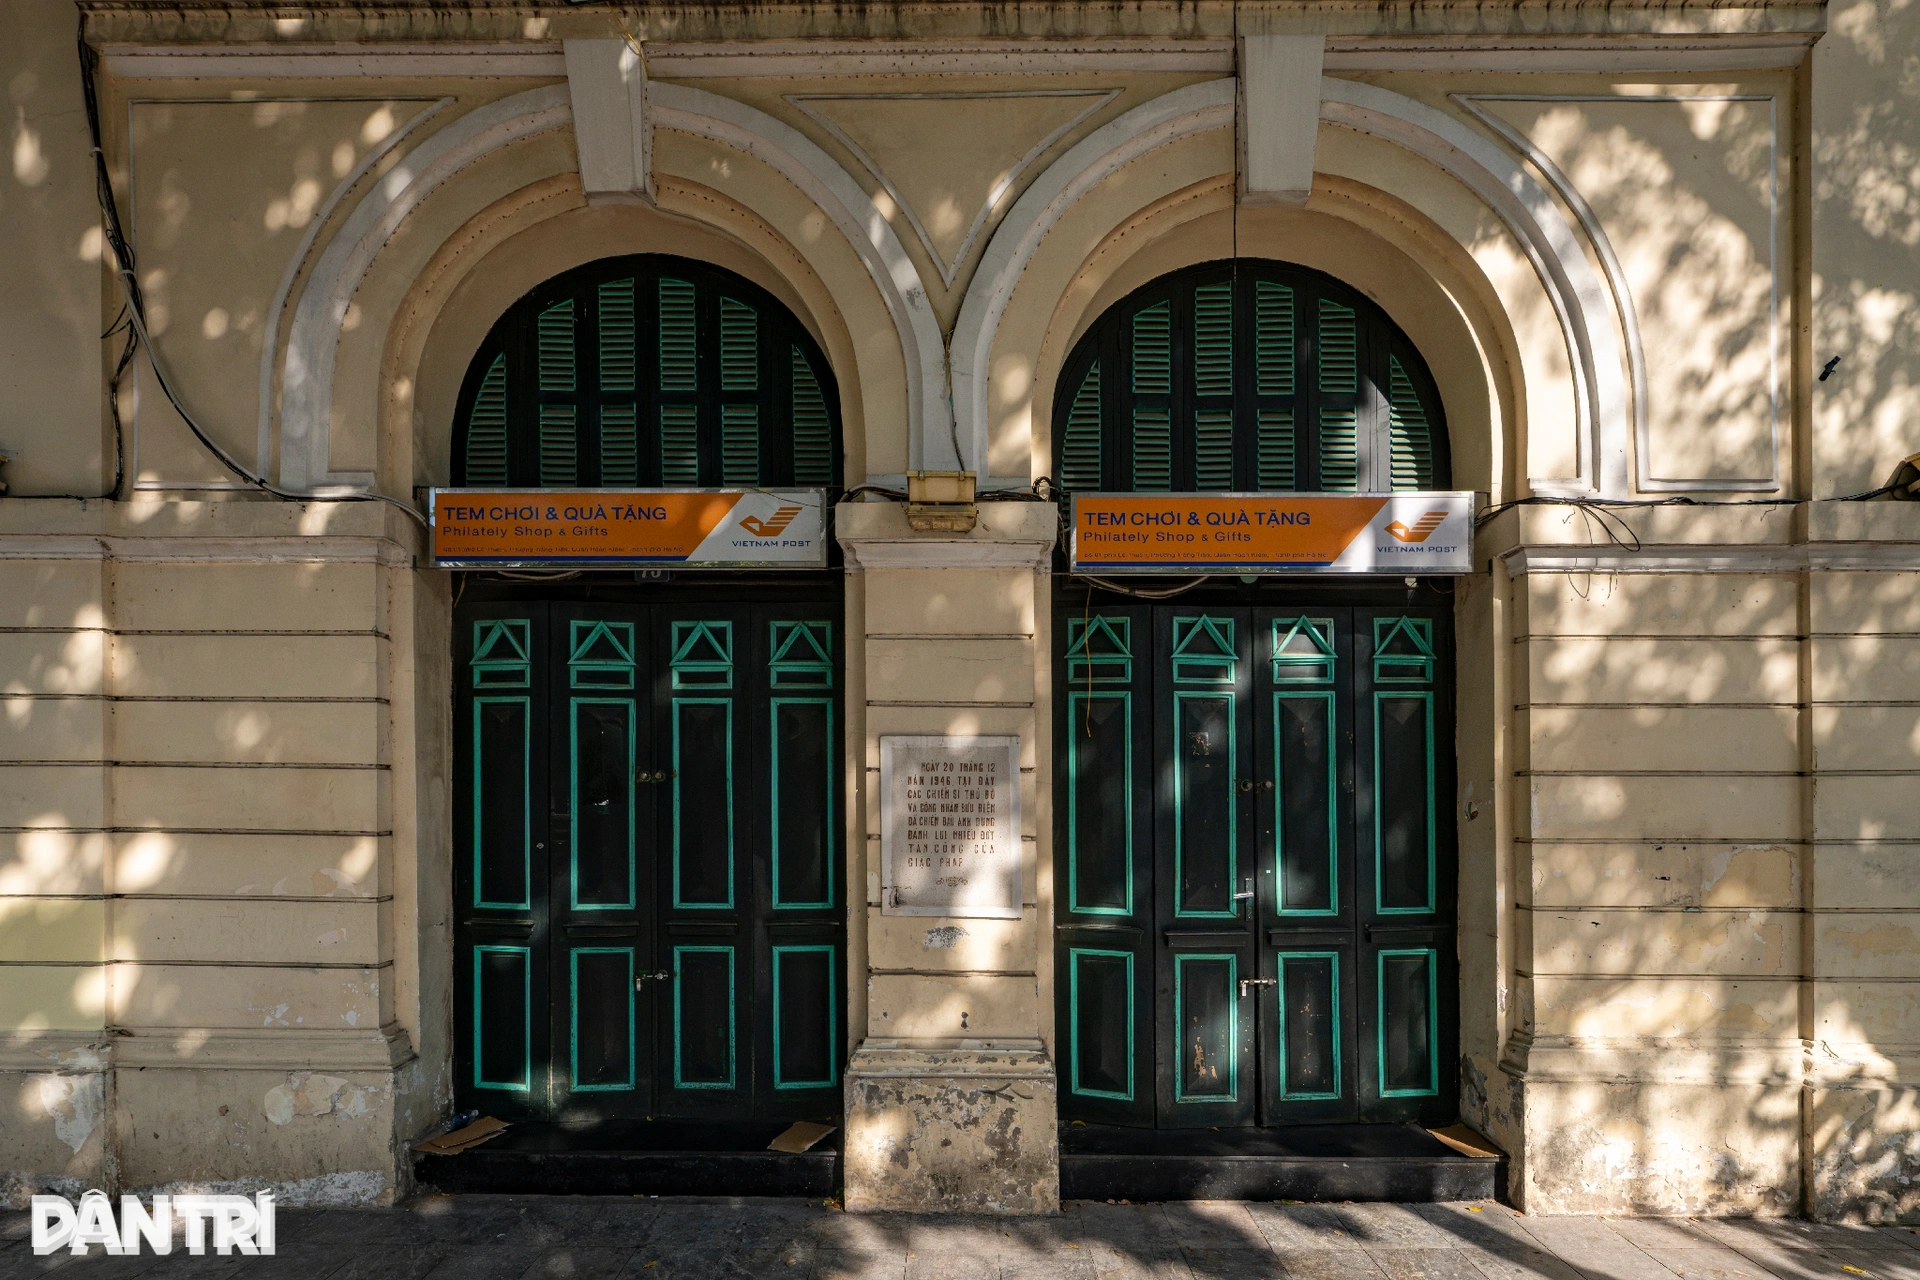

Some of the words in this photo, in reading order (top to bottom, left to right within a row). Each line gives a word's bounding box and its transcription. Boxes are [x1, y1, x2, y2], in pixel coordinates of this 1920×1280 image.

[443, 507, 485, 521] TEM
[489, 506, 539, 521] CHƠI
[545, 507, 560, 521] &
[564, 504, 607, 521] QUÀ
[611, 504, 667, 523] TẶNG
[1084, 512, 1127, 526] TEM
[1130, 511, 1181, 526] CHƠI
[1187, 512, 1201, 526] &
[1206, 509, 1250, 526] QUÀ
[1254, 509, 1310, 528] TẶNG
[443, 526, 508, 538] Philately
[514, 526, 553, 538] Shop
[558, 528, 567, 536] &
[572, 526, 608, 536] Gifts
[1084, 532, 1149, 544] Philately
[1156, 531, 1195, 543] Shop
[1201, 534, 1209, 542] &
[1214, 531, 1251, 542] Gifts
[731, 540, 779, 548] VIETNAM
[782, 540, 811, 548] POST
[943, 762, 954, 772] 20
[987, 762, 995, 772] 12
[958, 776, 971, 788] TẠI
